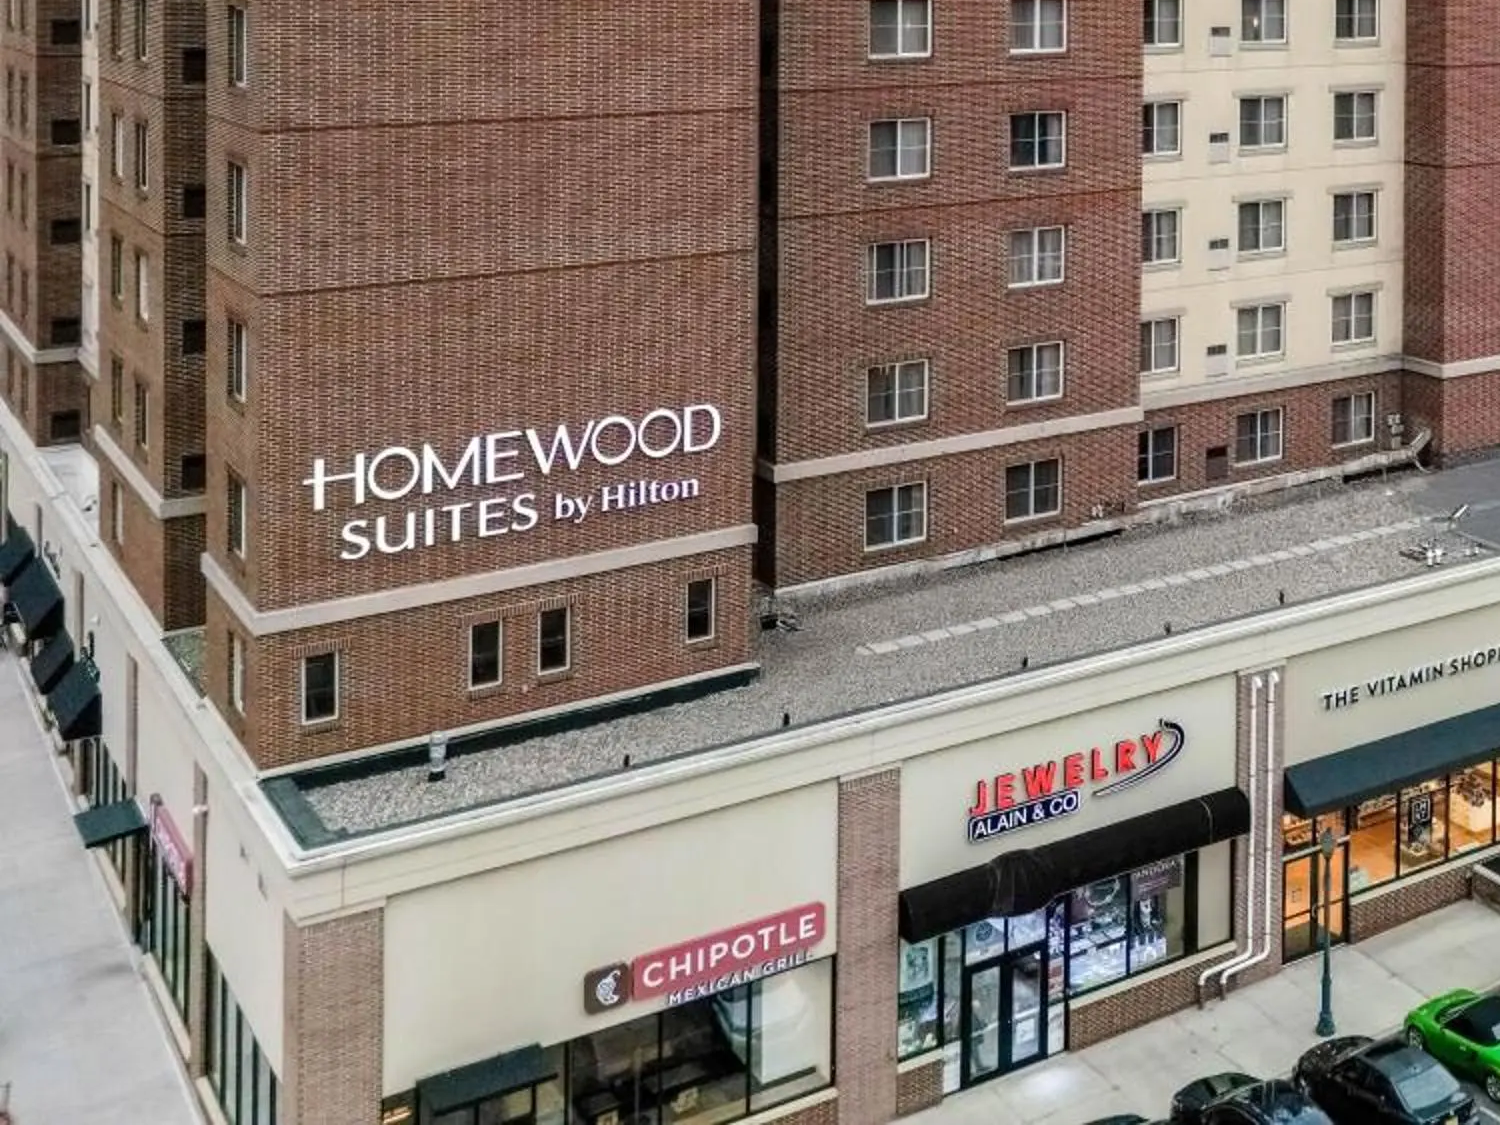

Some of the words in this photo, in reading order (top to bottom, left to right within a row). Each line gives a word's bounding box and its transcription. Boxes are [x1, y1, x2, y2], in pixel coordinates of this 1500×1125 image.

[303, 403, 722, 510] HOMEWOOD
[340, 494, 538, 560] SUITES
[554, 492, 594, 524] by
[602, 478, 700, 512] Hilton
[1323, 684, 1360, 712] THE
[1367, 662, 1446, 697] VITAMIN
[968, 730, 1164, 816] JEWELRY
[974, 810, 1028, 838] ALAIN
[1032, 805, 1046, 822] &
[1049, 793, 1078, 815] CO
[641, 912, 818, 988] CHIPOTLE
[668, 968, 756, 1005] MEXICAN
[762, 950, 815, 975] GRILL
